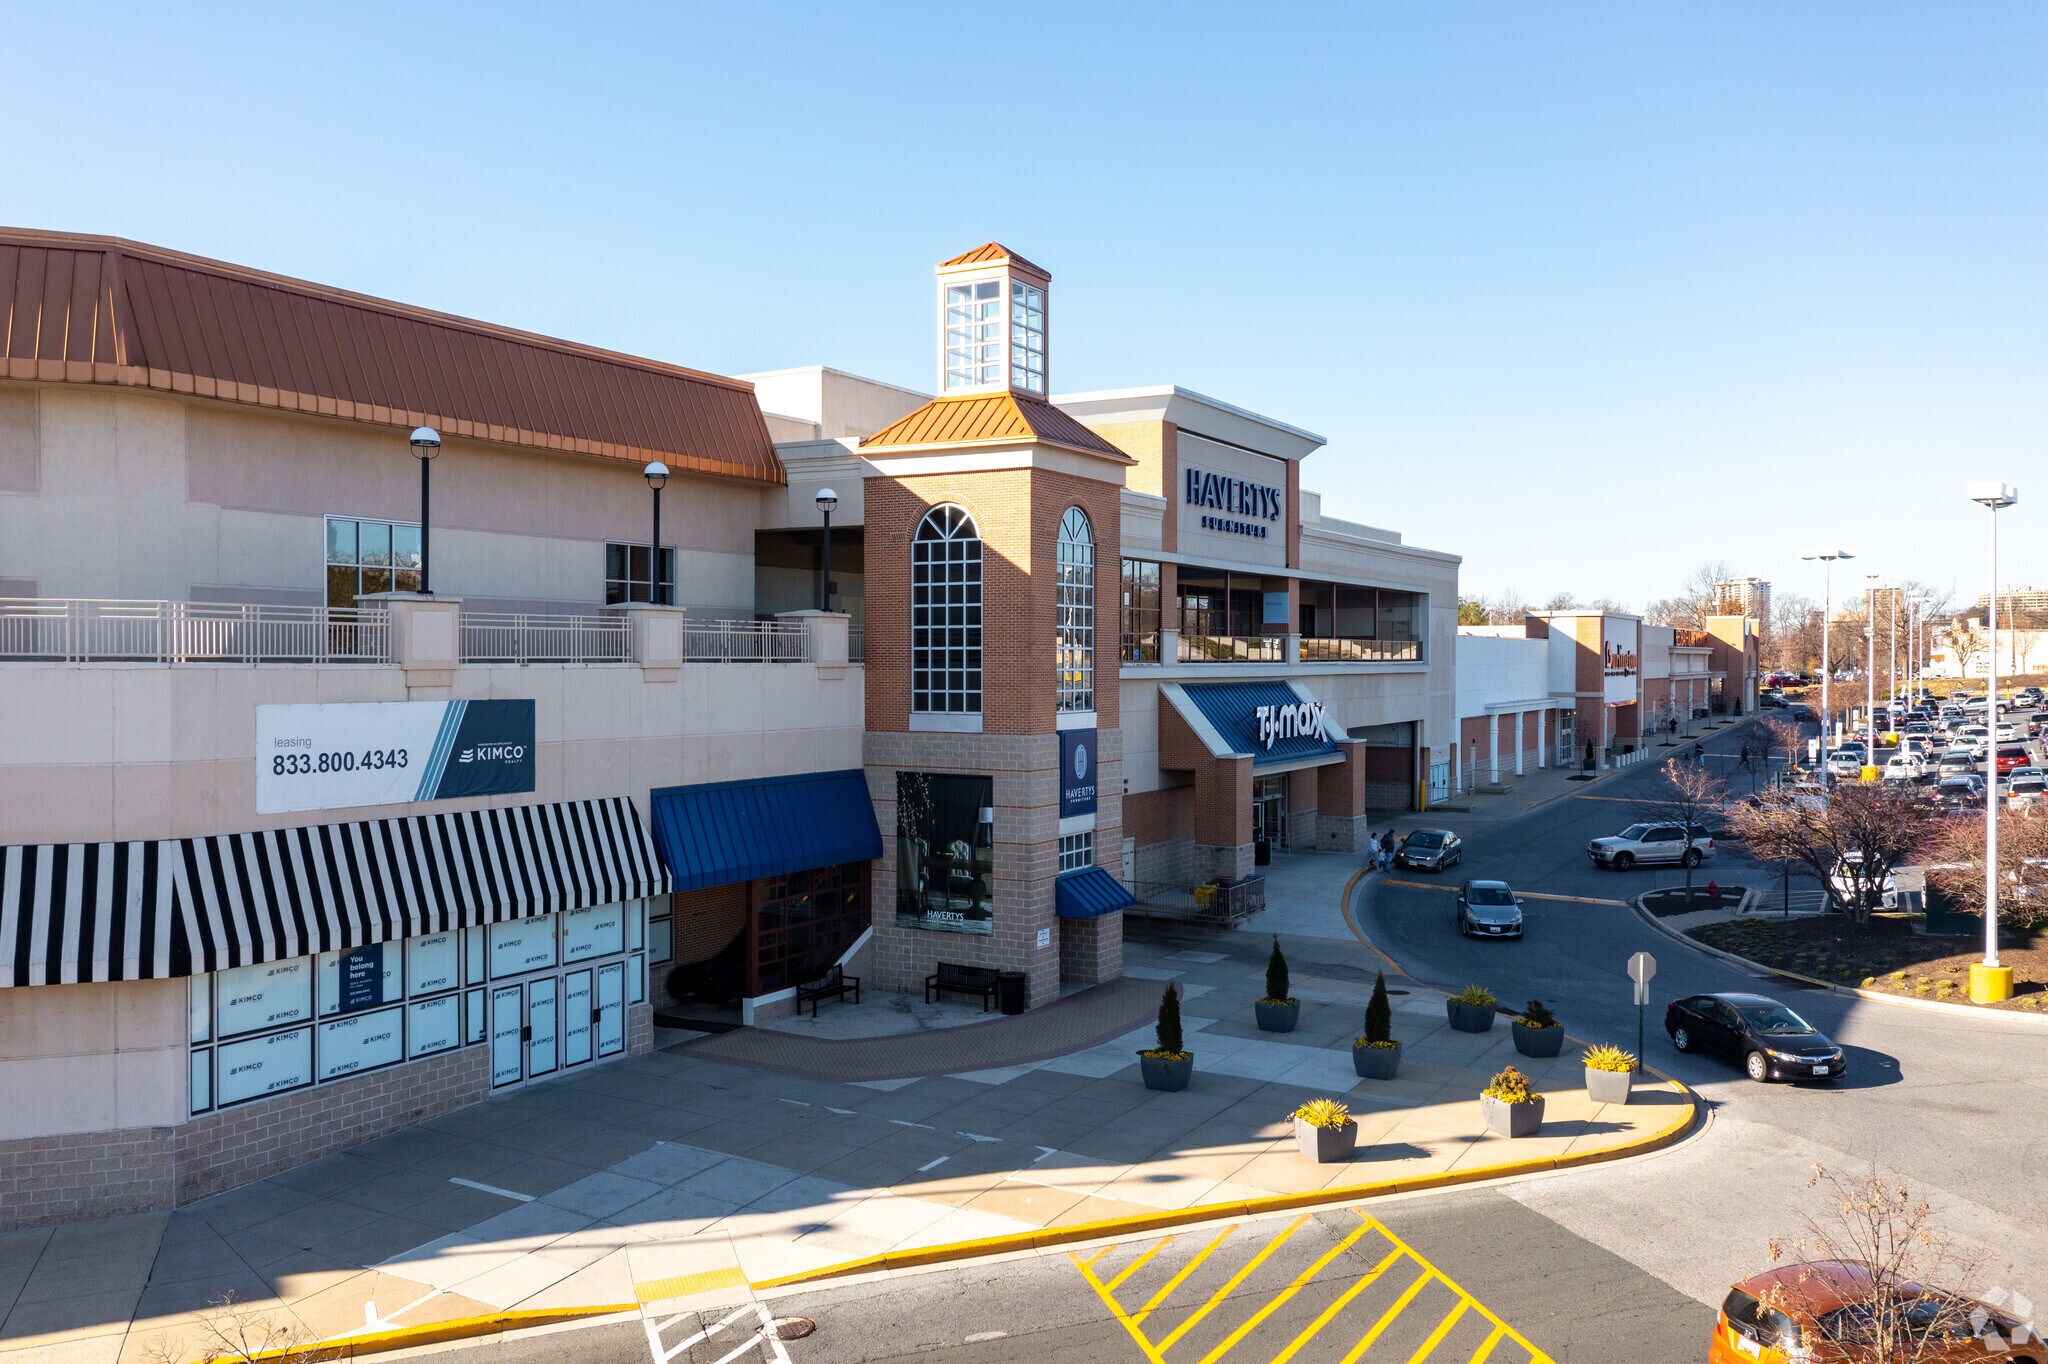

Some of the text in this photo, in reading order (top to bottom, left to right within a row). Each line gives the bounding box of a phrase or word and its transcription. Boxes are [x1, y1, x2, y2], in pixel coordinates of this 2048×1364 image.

[1186, 468, 1281, 521] HAVERTYS
[1202, 516, 1269, 538] FURNITURE
[274, 737, 312, 749] leasing
[477, 746, 524, 760] KIMCO
[273, 749, 408, 776] 833.800.4343
[1066, 785, 1095, 799] HAVERTYS
[927, 910, 964, 921] HAVERTYS
[276, 965, 299, 975] KIMCO
[350, 962, 374, 971] belong
[350, 971, 366, 979] here
[427, 978, 446, 986] KIMCO
[238, 994, 263, 1004] KIMCO
[573, 990, 588, 998] KIMCO
[427, 999, 446, 1008] KIMCO
[276, 1009, 299, 1019] KIMCO
[336, 1019, 358, 1028] KIMCO
[573, 1027, 588, 1035] KIMCO
[276, 1032, 299, 1042] KIMCO
[370, 1033, 391, 1043] KIMCO
[537, 1036, 554, 1045] KIMCO
[427, 1040, 446, 1049] KIMCO
[238, 1062, 263, 1072] KIMCO
[337, 1062, 358, 1072] KIMCO
[276, 1077, 299, 1087] KIMCO
